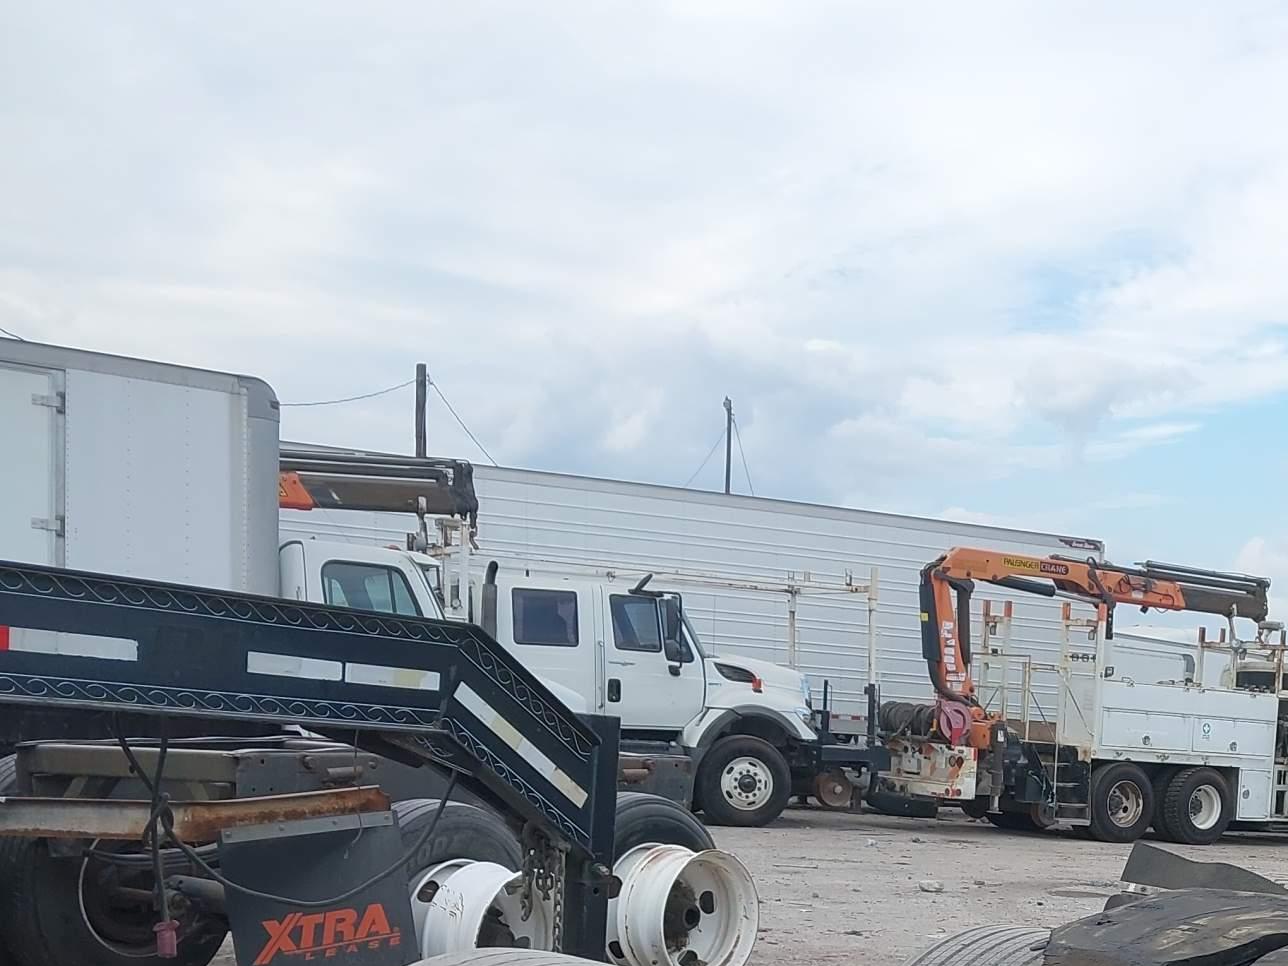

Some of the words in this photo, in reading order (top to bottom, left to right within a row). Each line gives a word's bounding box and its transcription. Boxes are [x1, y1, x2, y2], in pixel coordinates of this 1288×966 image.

[1041, 563, 1068, 575] CRANE
[252, 903, 393, 966] XTRA
[304, 938, 401, 961] LEASE
